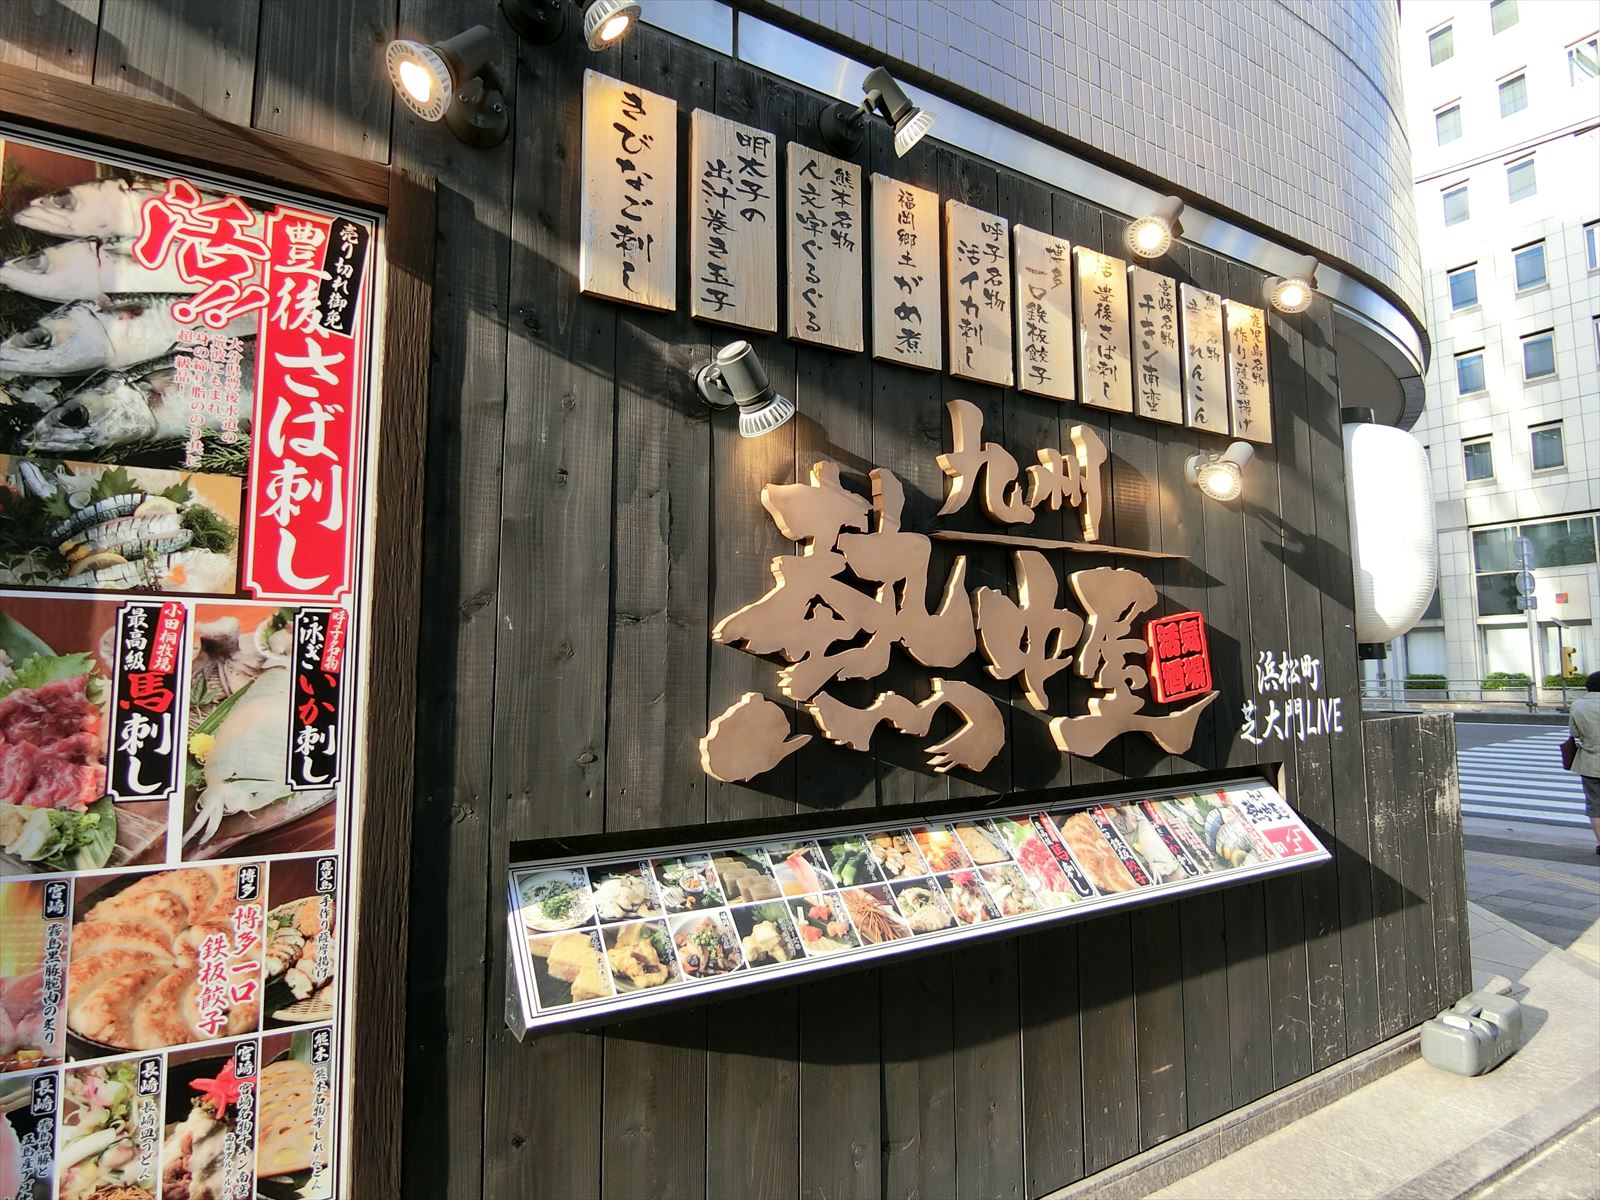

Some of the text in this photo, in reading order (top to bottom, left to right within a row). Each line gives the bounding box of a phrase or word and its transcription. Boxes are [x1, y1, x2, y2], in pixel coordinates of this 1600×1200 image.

[609, 91, 655, 293] きびなご刺し
[736, 131, 771, 223] 明太子の
[830, 168, 855, 252] 熊本名物
[323, 222, 360, 330] 売り切れ御免
[700, 159, 736, 312] 出汁巻き玉子
[796, 160, 828, 333] 人文字ぐるぐる
[893, 188, 923, 354] 福岡郷土がめ煮
[981, 222, 1006, 312] 呼子名物
[1046, 244, 1067, 289] 博多
[957, 239, 983, 369] 活イカ刺し
[1025, 266, 1052, 385] 一口鉄板餃子
[1158, 280, 1175, 348] 宮崎名物
[222, 337, 244, 443] 大分県豊後水道の
[1139, 294, 1161, 412] チキン南蛮
[1233, 320, 1253, 432] 作り薩摩揚げ
[260, 221, 345, 590] 豊後さば刺し
[936, 399, 1108, 541] 九州
[152, 603, 183, 671] 小田桐牧場
[325, 610, 347, 670] 呼子名物
[700, 460, 1220, 782] 熱中屋
[295, 617, 336, 783] 泳ぎいか刺し
[1256, 651, 1320, 694] 浜松町
[46, 884, 65, 915] 宮崎
[239, 869, 257, 898] 博多
[199, 937, 228, 1034] 鉄板餃子
[231, 907, 260, 1003] 博多一口
[141, 1061, 159, 1093] 長崎
[237, 1046, 254, 1075] 宮崎
[313, 1032, 330, 1061] 熊本
[34, 1079, 55, 1111] 長崎
[139, 1101, 155, 1179] 長崎皿うどん
